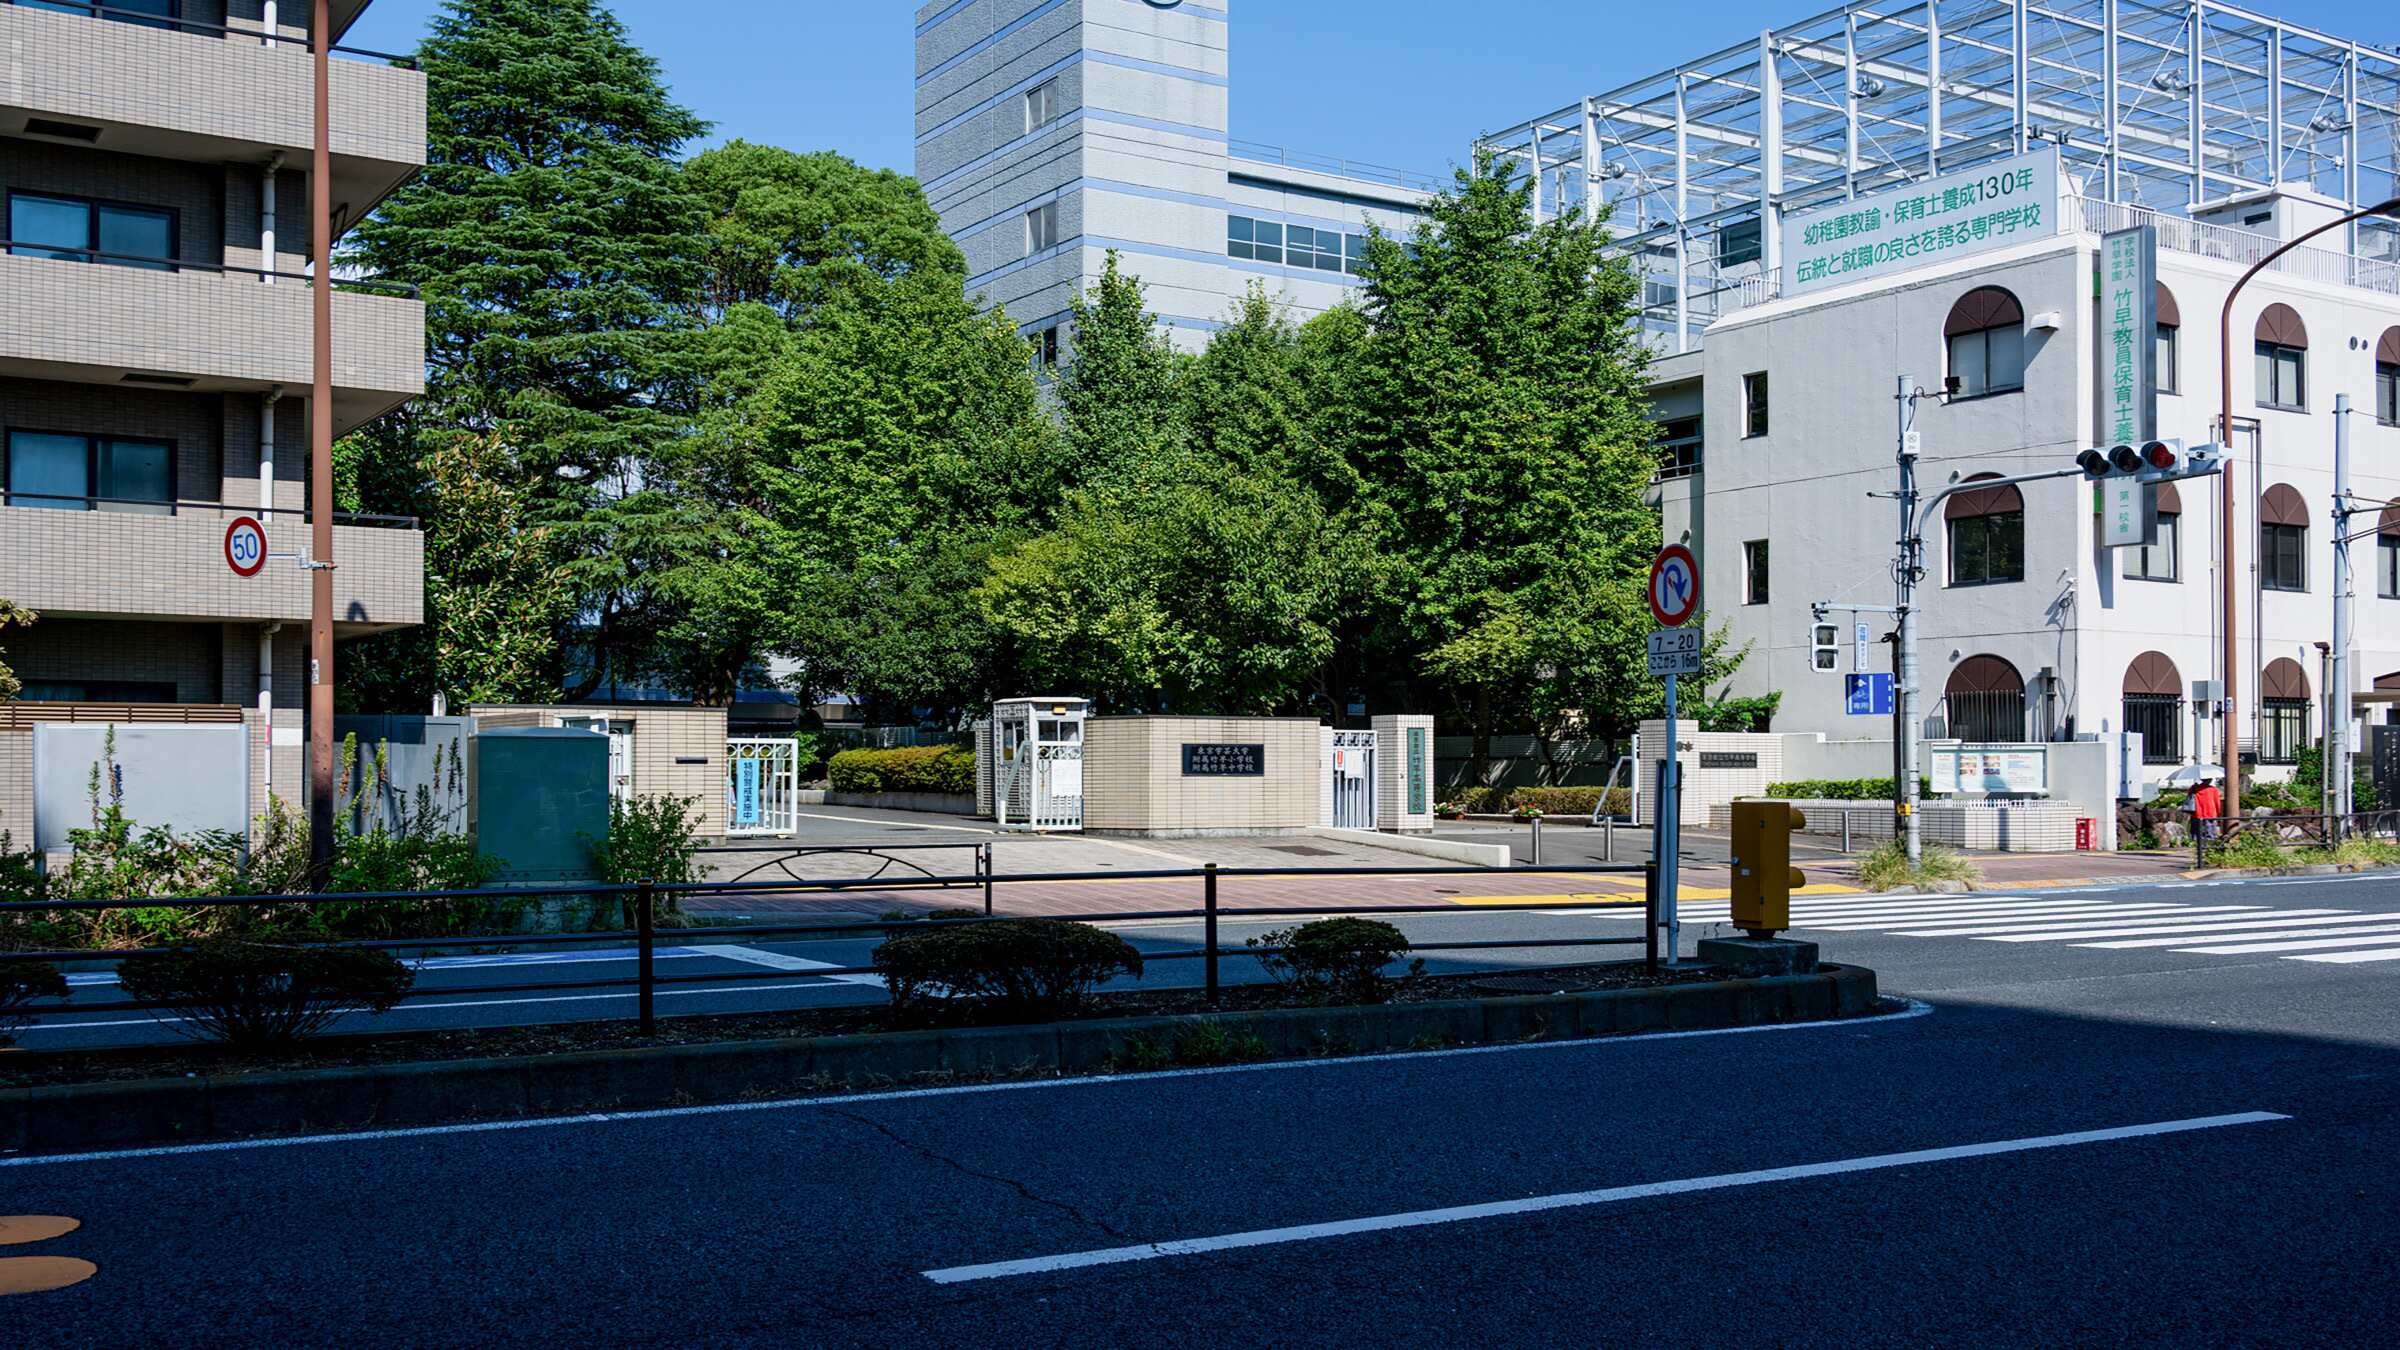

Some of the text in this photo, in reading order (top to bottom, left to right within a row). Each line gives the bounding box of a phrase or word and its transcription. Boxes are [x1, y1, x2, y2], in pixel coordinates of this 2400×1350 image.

[1796, 202, 2042, 284] 伝統と就職の良さを誇る専門学校
[1803, 167, 2034, 246] 幼稚園教諭・保育士養成130年
[2112, 289, 2134, 480] 竹早教員保育士養
[233, 533, 257, 560] 50
